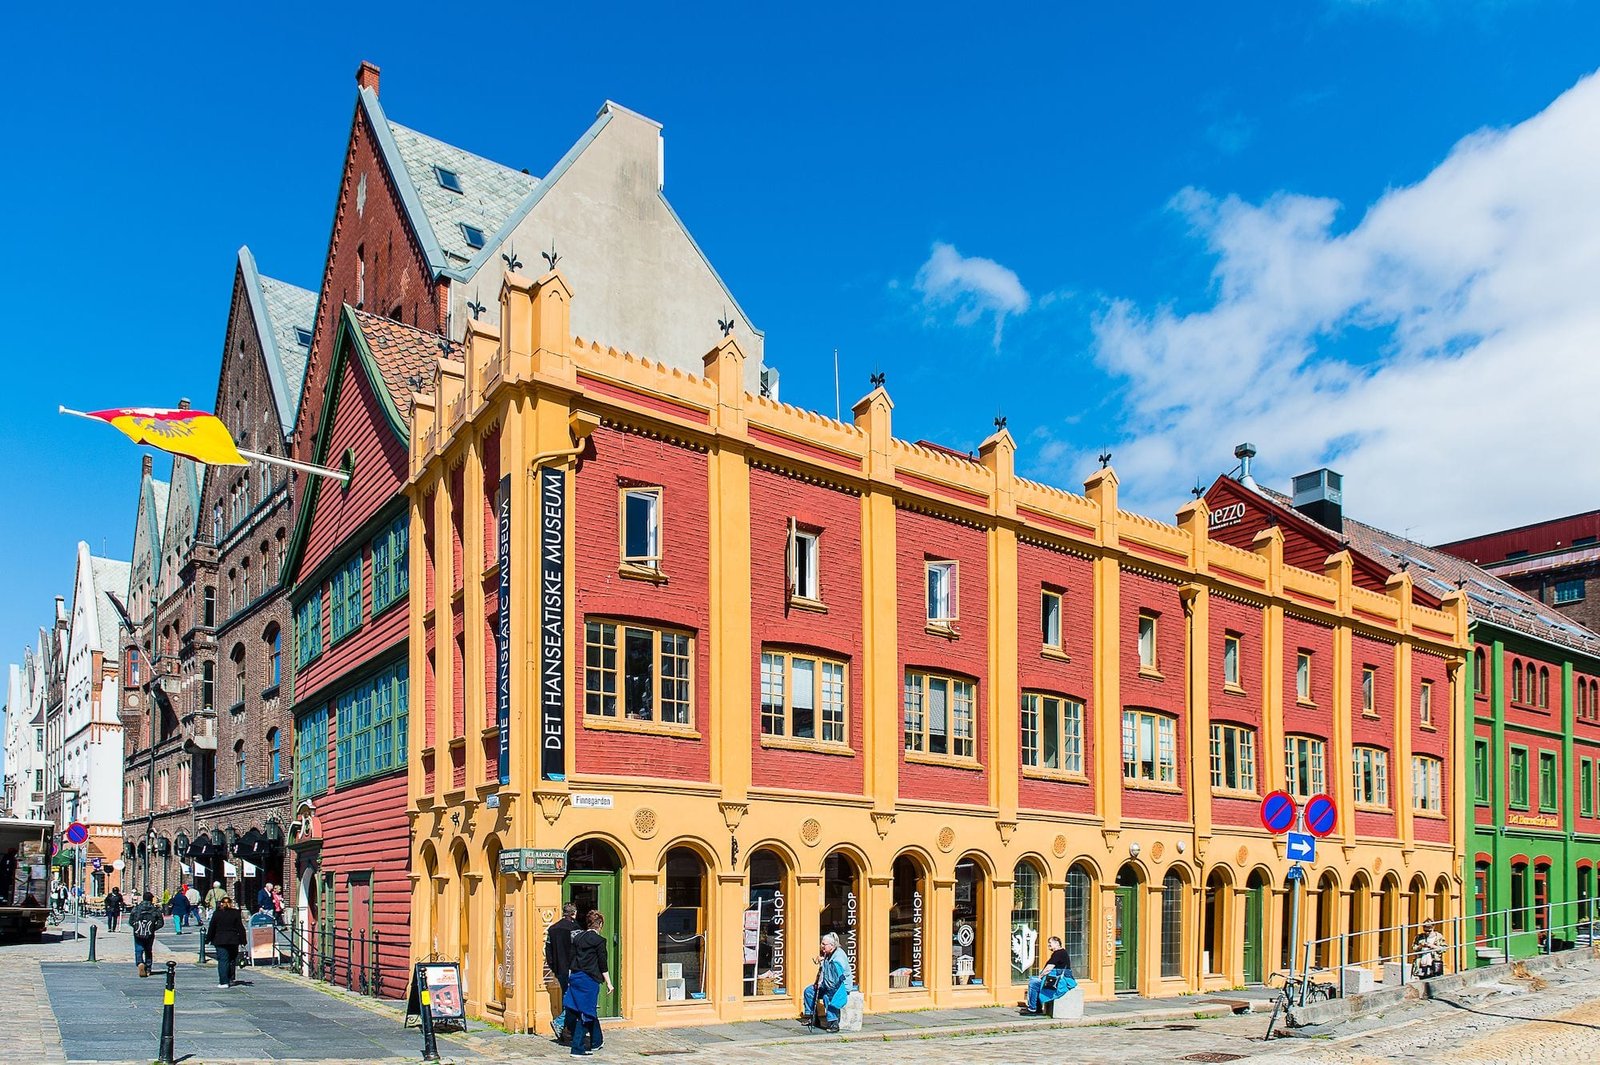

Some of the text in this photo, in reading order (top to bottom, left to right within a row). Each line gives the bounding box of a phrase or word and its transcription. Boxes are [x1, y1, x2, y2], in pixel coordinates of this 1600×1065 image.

[500, 497, 510, 755] THE HANSEATIC MUSEUM
[544, 473, 563, 751] DET HANSEATISKE MUSEUM
[774, 890, 785, 925] SHOP
[847, 892, 857, 926] SHOP
[913, 891, 923, 923] SHOP
[504, 910, 512, 985] ENTRANCE
[773, 929, 785, 985] MUSEUM
[913, 927, 922, 979] MUSEUM
[1106, 914, 1114, 957] KONTOR
